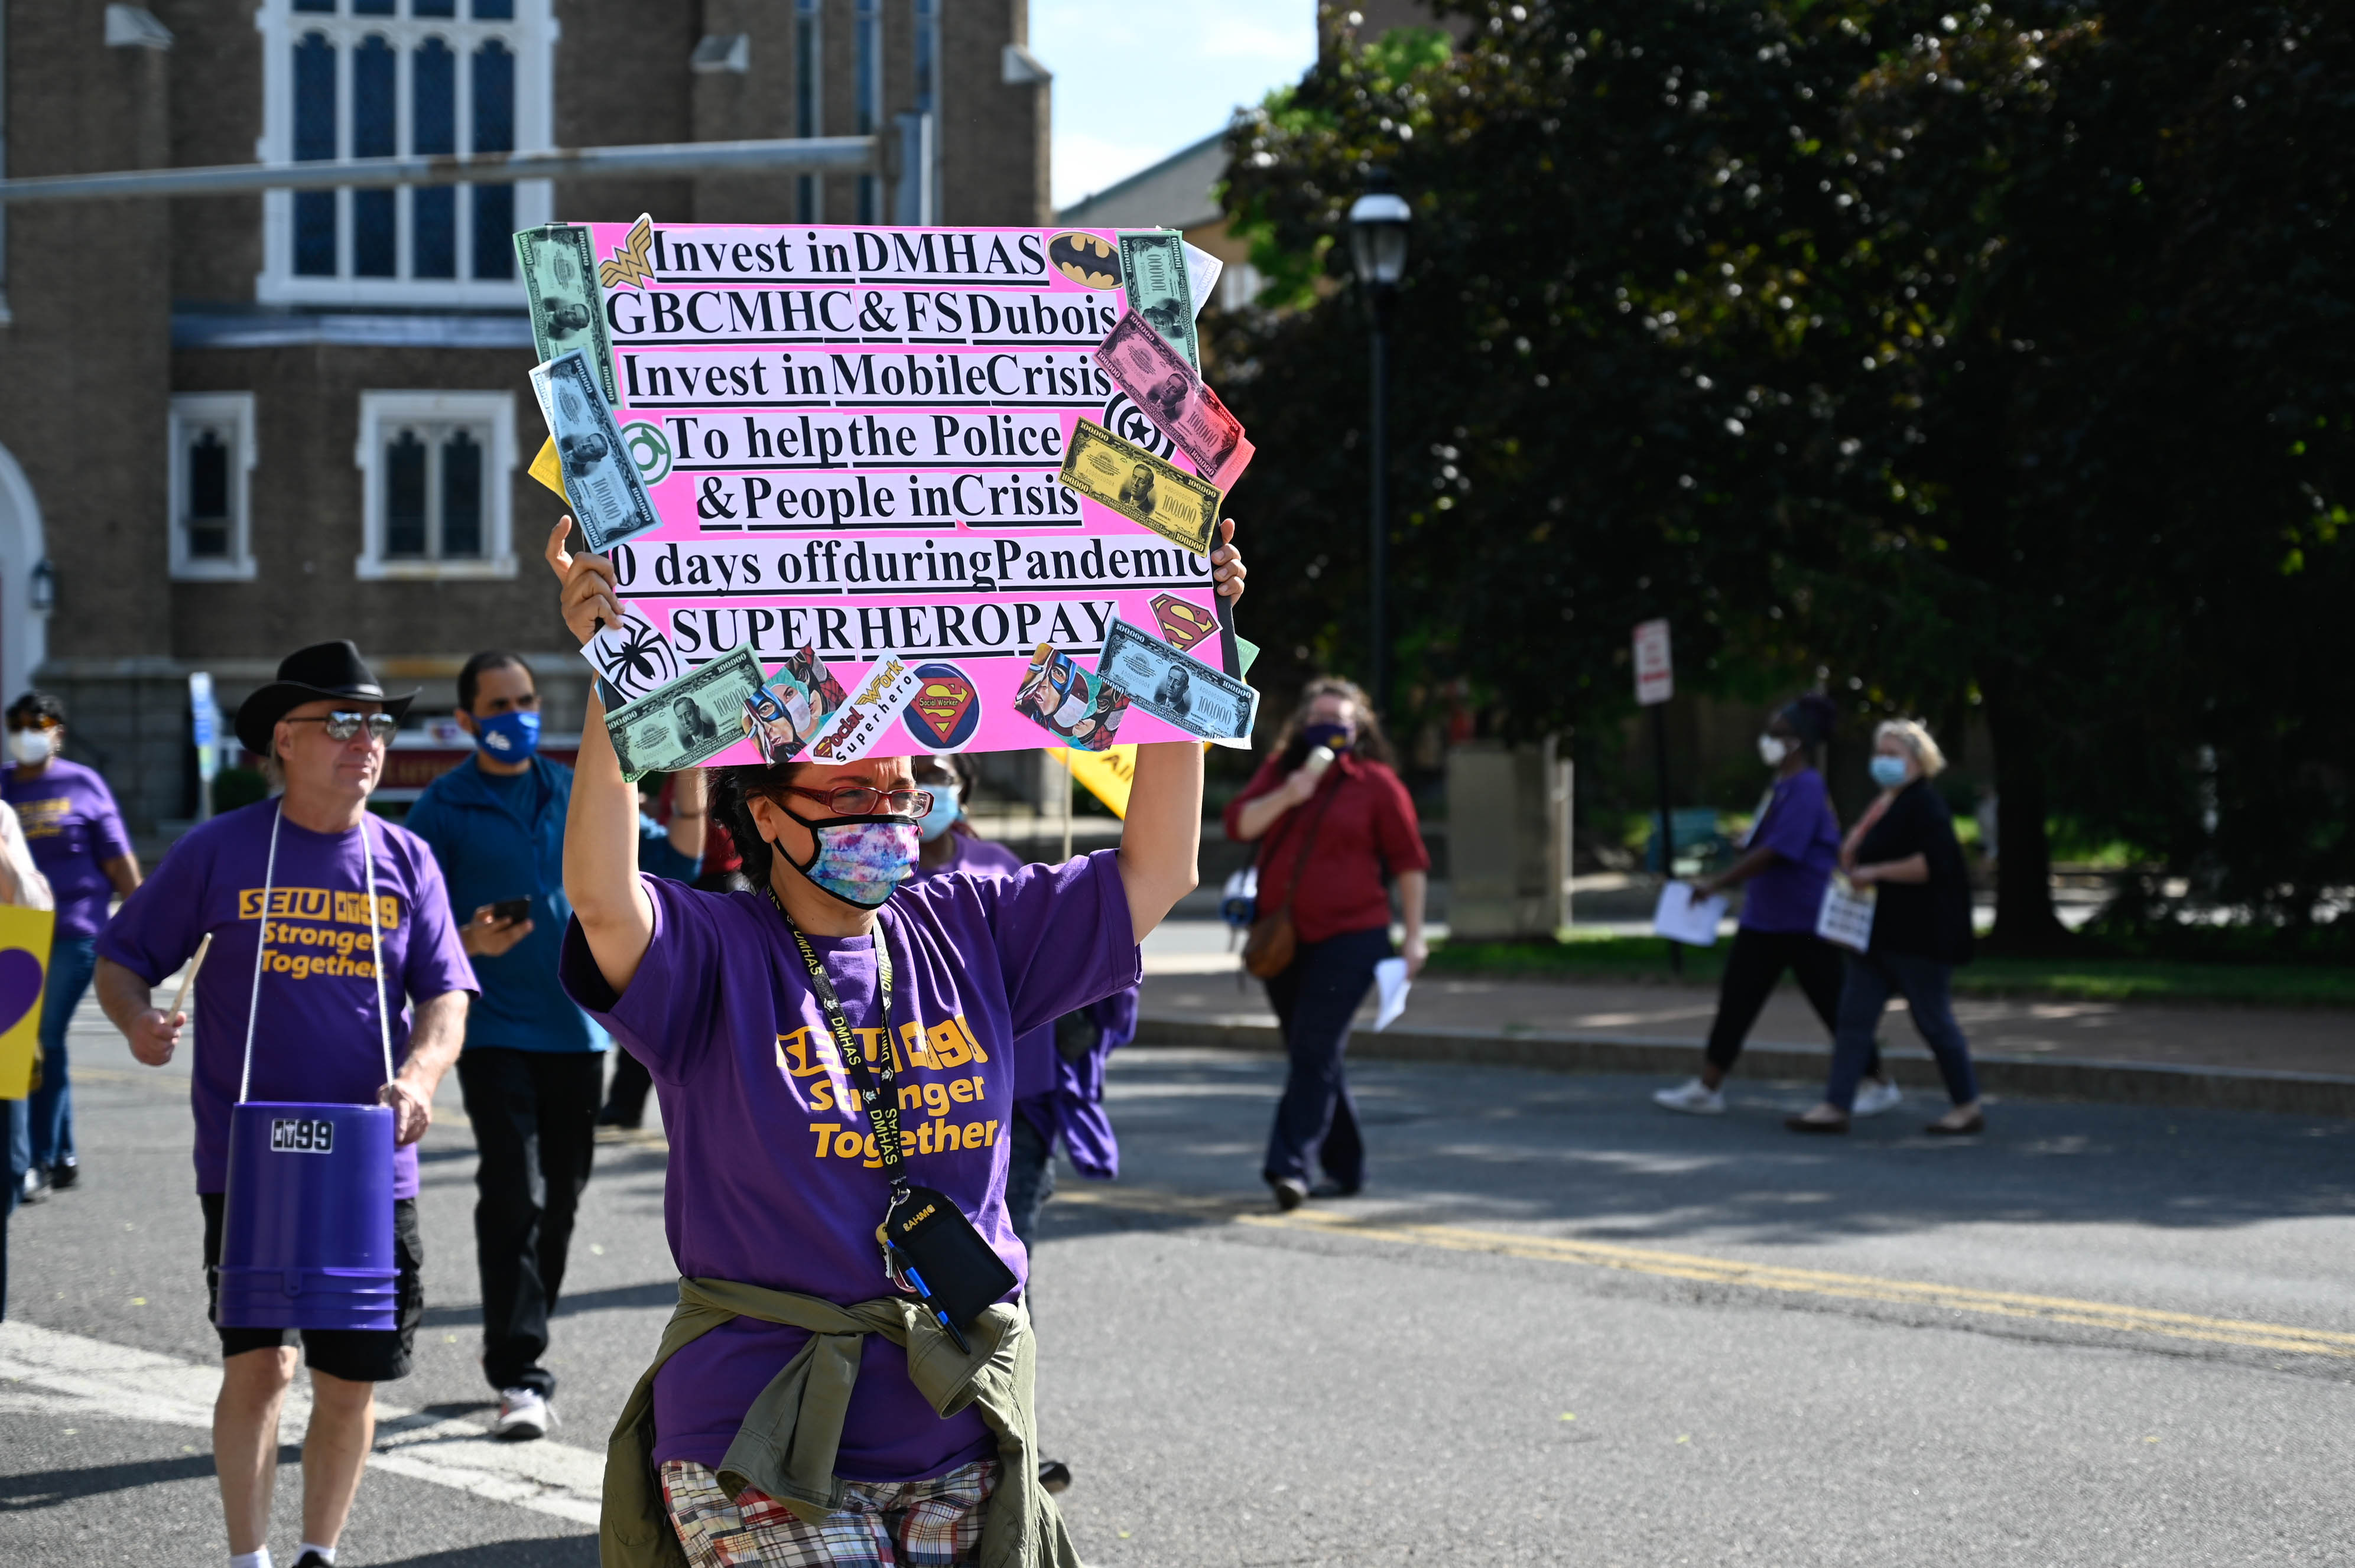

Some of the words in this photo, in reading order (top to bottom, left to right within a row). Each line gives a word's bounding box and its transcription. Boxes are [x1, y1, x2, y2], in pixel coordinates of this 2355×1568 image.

[654, 230, 794, 272] Invest
[966, 295, 1116, 335] Dubois
[623, 355, 769, 396] Invest
[829, 354, 986, 396] Mobile
[986, 354, 1111, 396] Crisis
[666, 417, 728, 459] To
[743, 415, 842, 468] help
[849, 415, 917, 456] the
[930, 415, 1062, 457] Police
[742, 476, 896, 529] People
[953, 474, 1079, 517] Crisis
[655, 543, 761, 596] days
[844, 540, 996, 592] during
[919, 698, 937, 707] Social
[937, 699, 959, 707] Worker
[831, 1016, 861, 1066] DMHAS
[809, 1075, 985, 1117] Strnger
[870, 1109, 898, 1165] DMHAS
